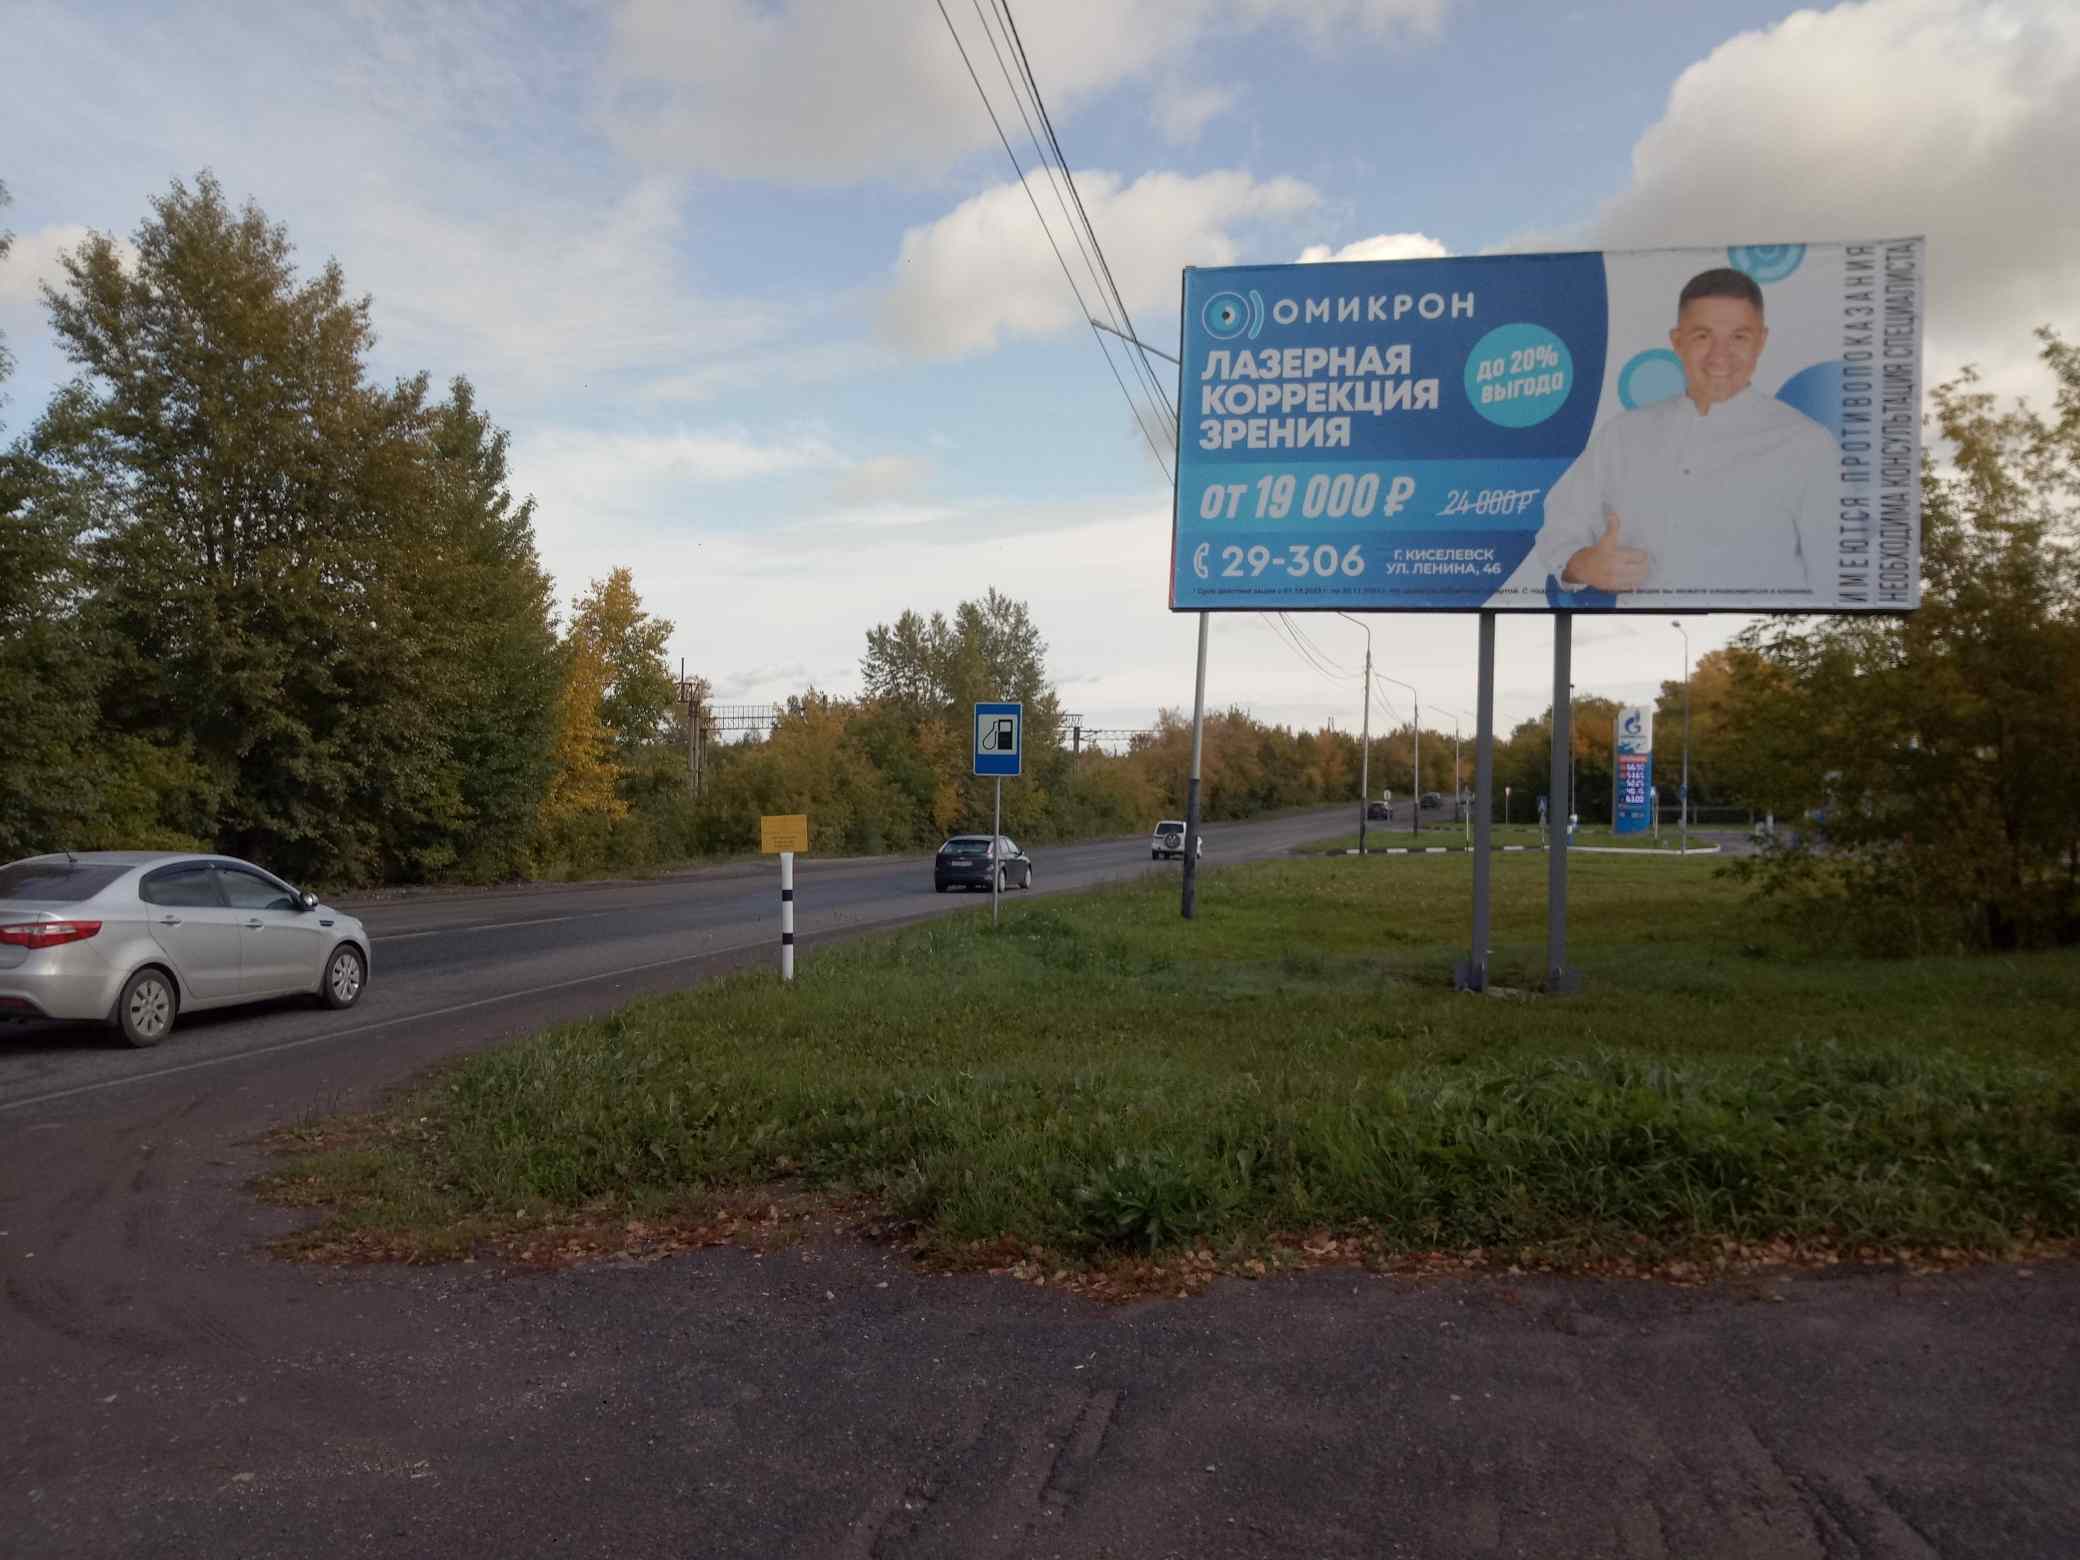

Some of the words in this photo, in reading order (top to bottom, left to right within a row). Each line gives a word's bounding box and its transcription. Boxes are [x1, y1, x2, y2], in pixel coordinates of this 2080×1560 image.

[1272, 292, 1475, 325] ОМИКРОН
[1883, 242, 1916, 359] СПЕЦИАЛИСТА
[1201, 344, 1412, 380] ЛАЗЕРНАЯ
[1510, 344, 1559, 375] 20%
[1841, 246, 1875, 482] ПРОТИВОПОКАЗАНИЯ
[1201, 378, 1440, 416] КОРРЕКЦИЯ
[1199, 416, 1352, 449] ЗРЕНИЯ
[1880, 363, 1914, 488] КОНСУЛЬТАЦИЯ
[1255, 474, 1297, 519] 19
[1302, 473, 1381, 518] 000
[1383, 476, 1416, 517] ₽
[1221, 544, 1366, 577] 29-306
[1406, 548, 1495, 561] КИСЕЛЕВСК
[1838, 497, 1871, 603] ИМЕЮТСЯ
[1877, 491, 1912, 603] НЕОБХОДИМА
[1386, 563, 1409, 576] УЛ.
[1412, 563, 1480, 576] ЛЕНИНА,
[1483, 563, 1502, 575] 46
